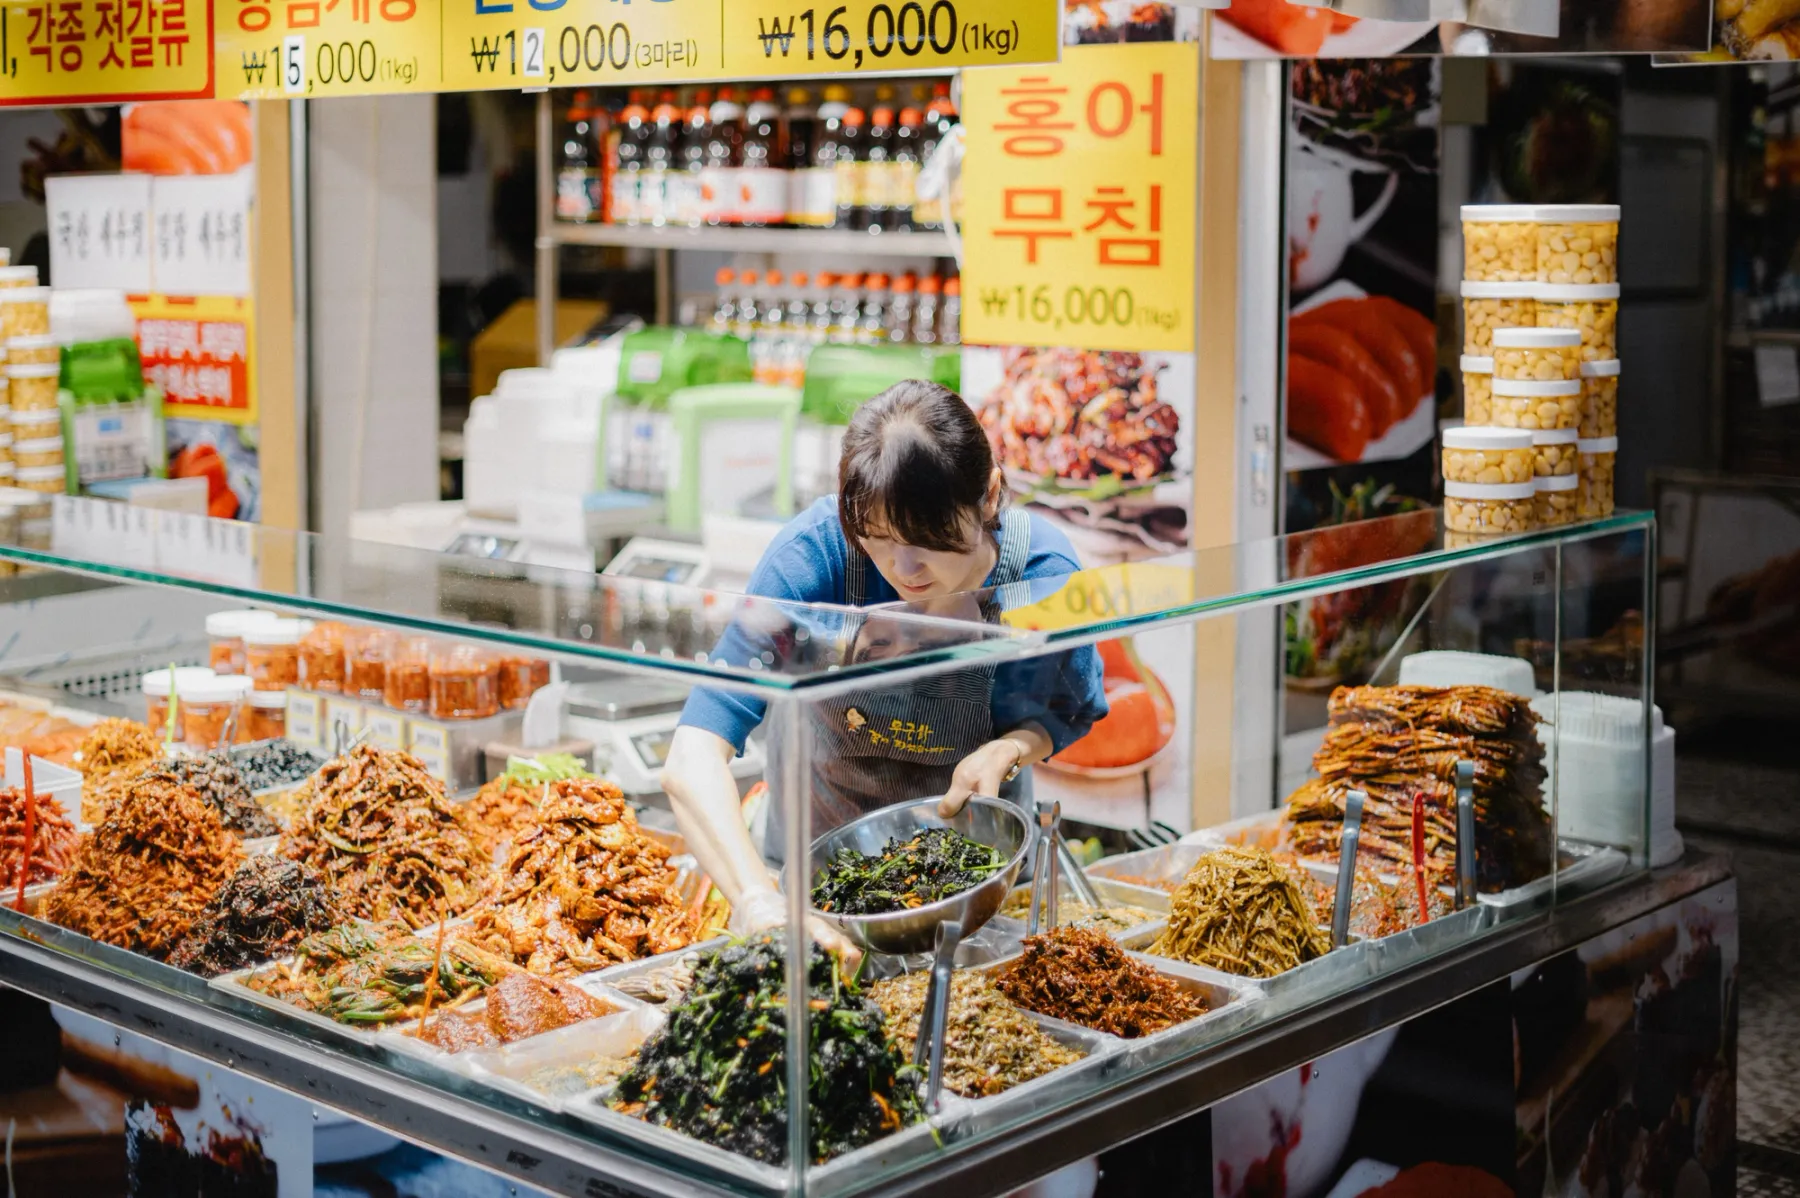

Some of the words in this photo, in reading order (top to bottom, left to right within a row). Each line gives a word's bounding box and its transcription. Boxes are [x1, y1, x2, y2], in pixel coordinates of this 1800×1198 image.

[26, 2, 86, 73] 각종
[94, 0, 190, 71] 젓갈류
[992, 73, 1164, 157] 홍어
[992, 184, 1162, 267] 무침
